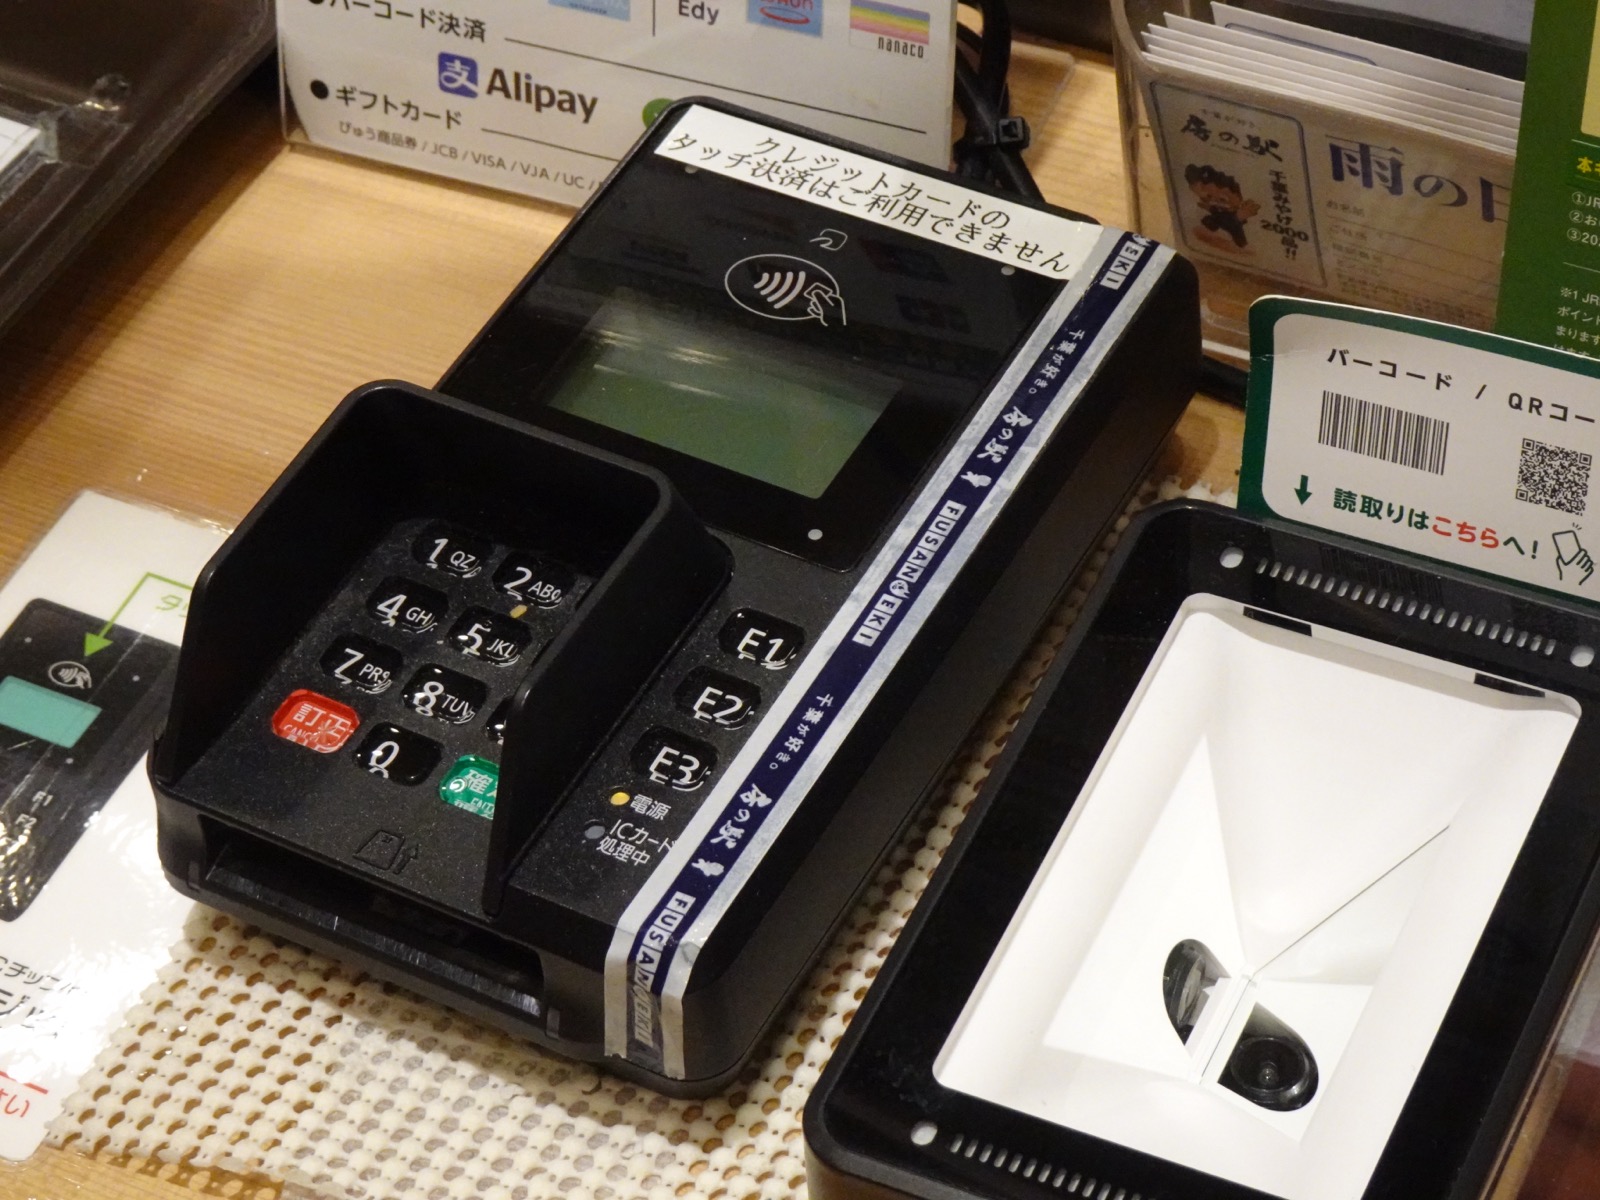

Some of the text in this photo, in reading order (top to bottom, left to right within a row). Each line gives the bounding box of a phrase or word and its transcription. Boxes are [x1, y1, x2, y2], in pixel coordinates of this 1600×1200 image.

[678, 0, 720, 25] Edy
[878, 36, 924, 59] nanaco
[335, 86, 462, 129] ギフトカード
[486, 67, 598, 124] Alipay
[338, 120, 417, 151] びゅう商品券
[432, 142, 459, 159] JCB
[471, 151, 507, 170] VISA
[520, 163, 550, 181] VJA
[563, 174, 585, 190] UC
[667, 132, 1071, 274] タッチ決済はご利用できません
[755, 136, 1011, 230] クレジットカードの
[1327, 348, 1452, 391] バーコード
[1507, 392, 1596, 424] QRコー
[976, 405, 1034, 464] 房の駅
[1333, 487, 1539, 560] 読取りはこちらへ!
[426, 538, 448, 568] 1
[503, 566, 532, 597] 2
[376, 593, 407, 622] 4
[464, 623, 491, 653] 5
[736, 627, 786, 664] E1
[334, 647, 364, 679] 7
[692, 686, 744, 725] E2
[769, 693, 834, 771] 千葉が好き。
[648, 745, 701, 786] E3
[630, 793, 672, 821] 電源
[709, 783, 773, 849] 房の駅
[596, 835, 651, 867] 処理中
